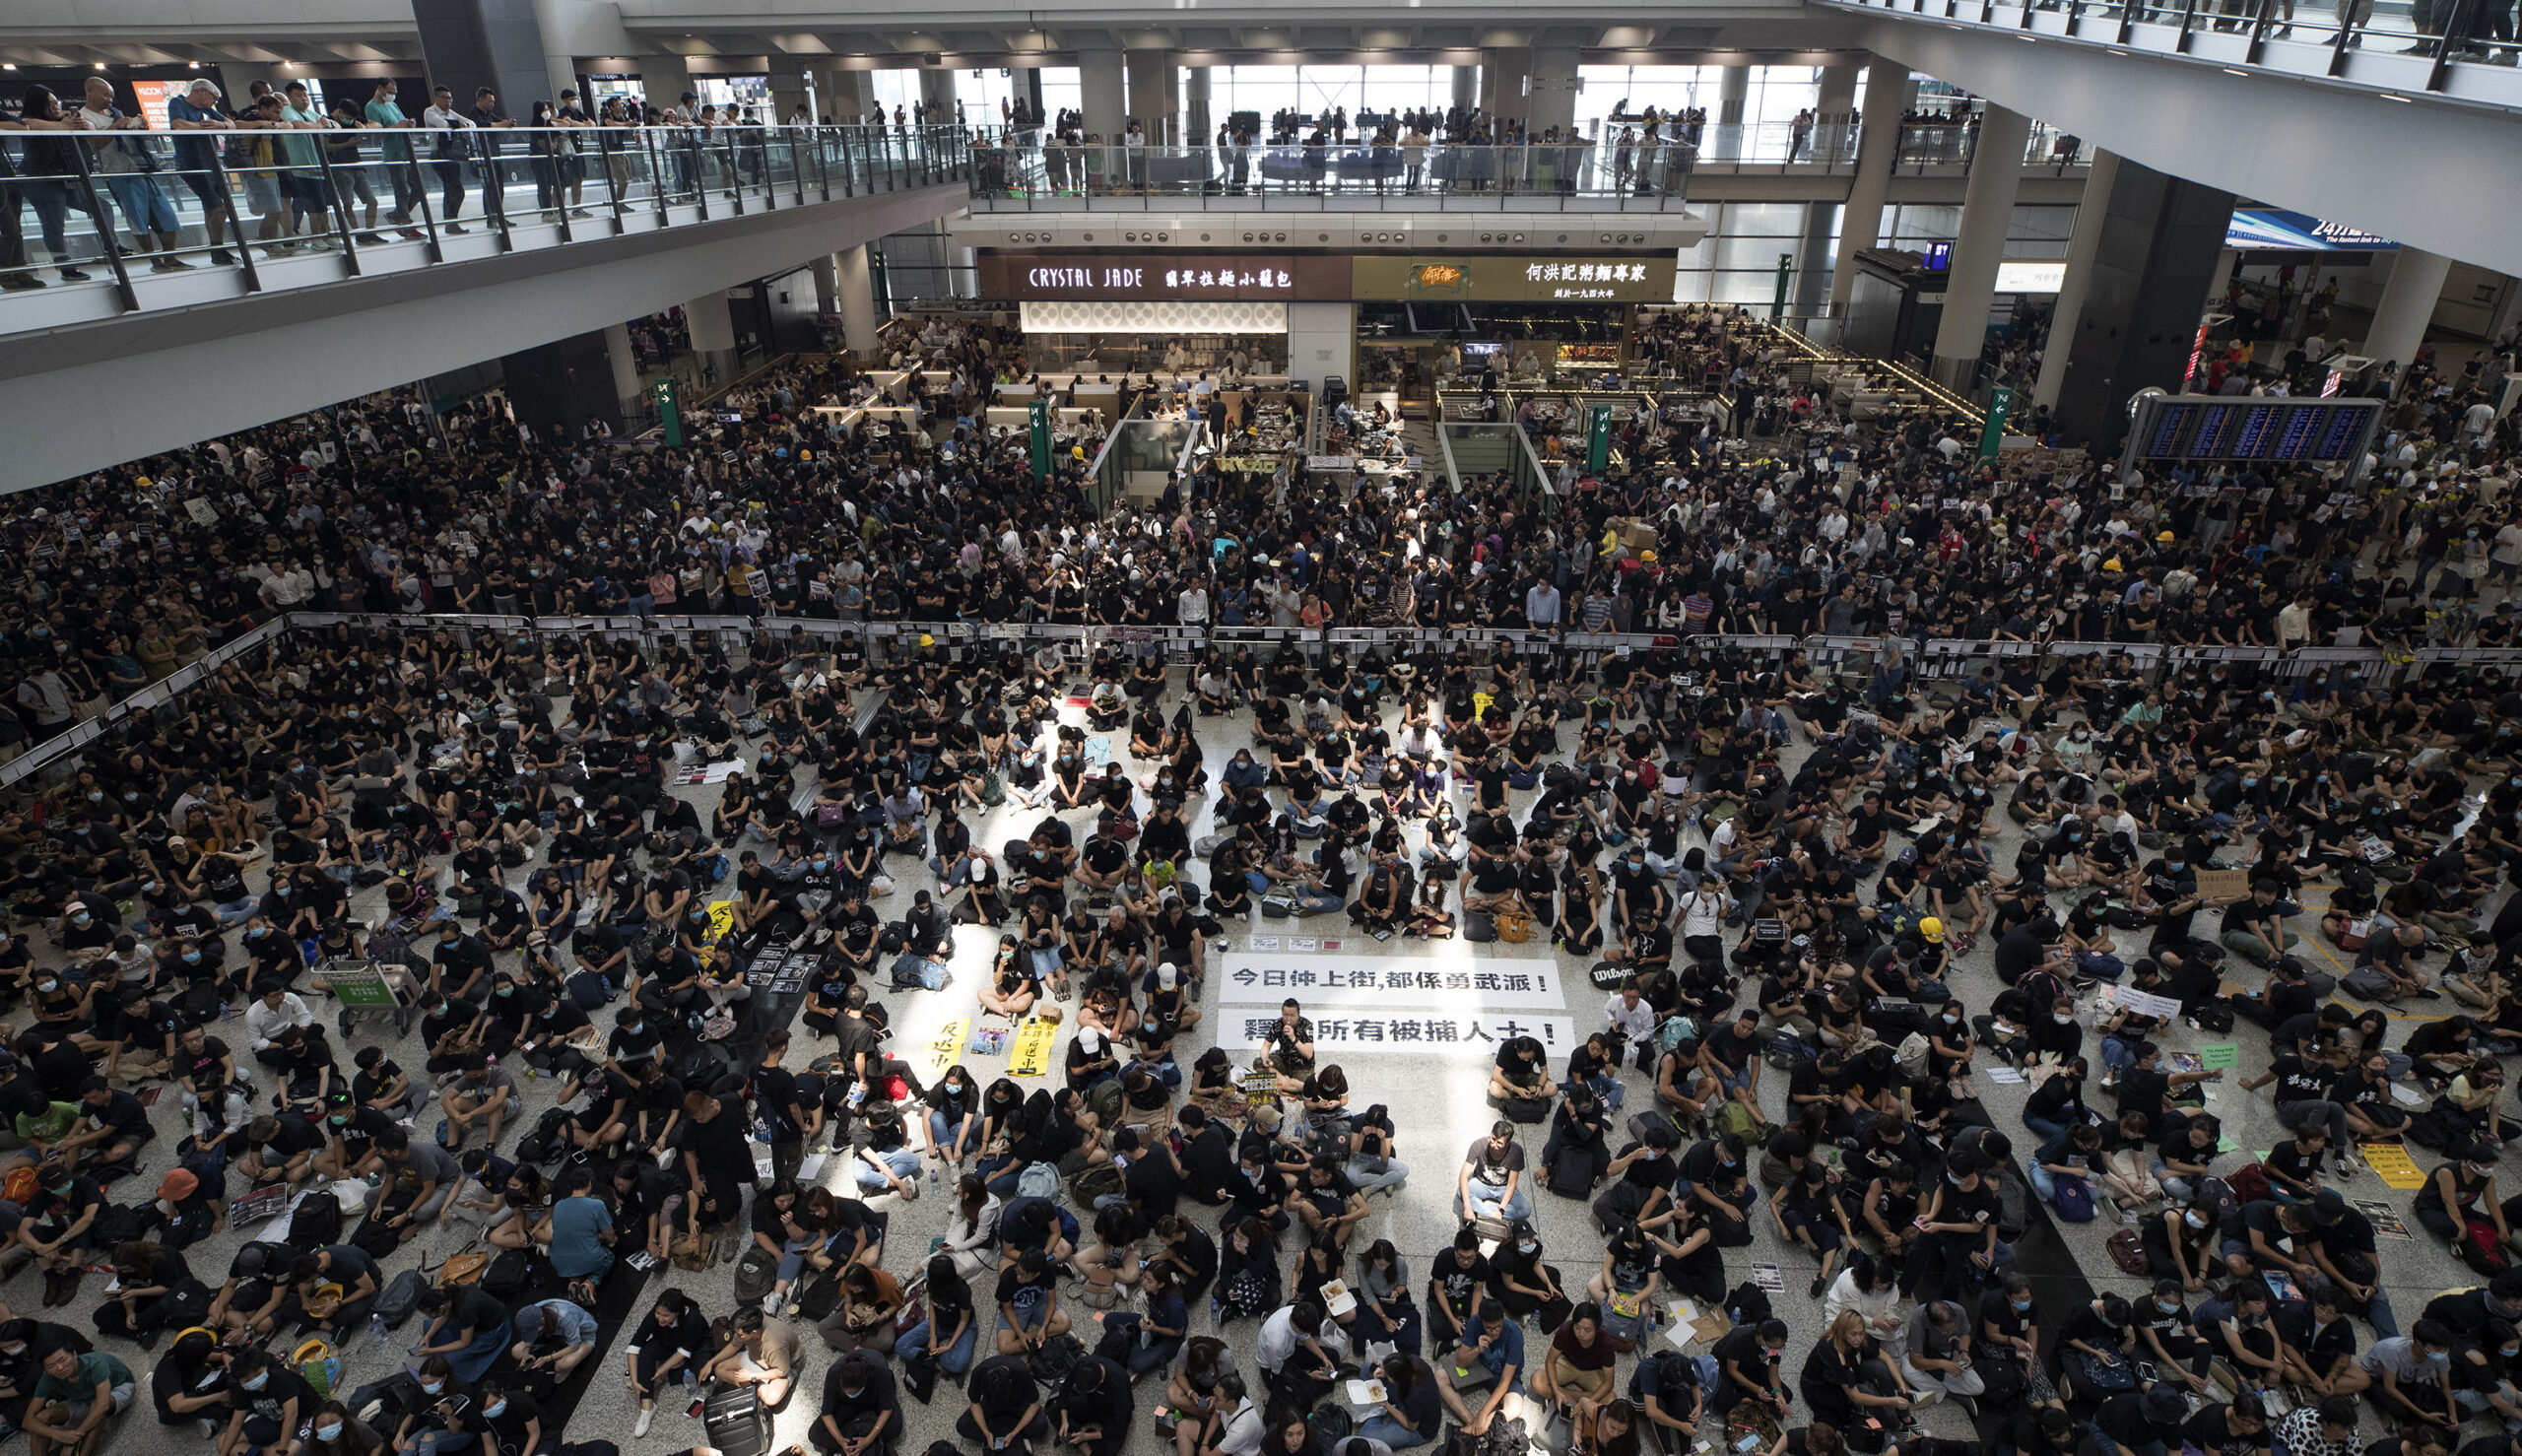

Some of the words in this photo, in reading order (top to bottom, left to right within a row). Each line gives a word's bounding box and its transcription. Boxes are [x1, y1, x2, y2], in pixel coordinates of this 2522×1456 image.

[138, 87, 164, 96] KLOOK
[1029, 268, 1094, 287] CRYSTAL
[1103, 268, 1143, 287] JADE
[1593, 967, 1635, 982] Wilson
[1244, 1019, 1555, 1045] 釋所有被捕人士!
